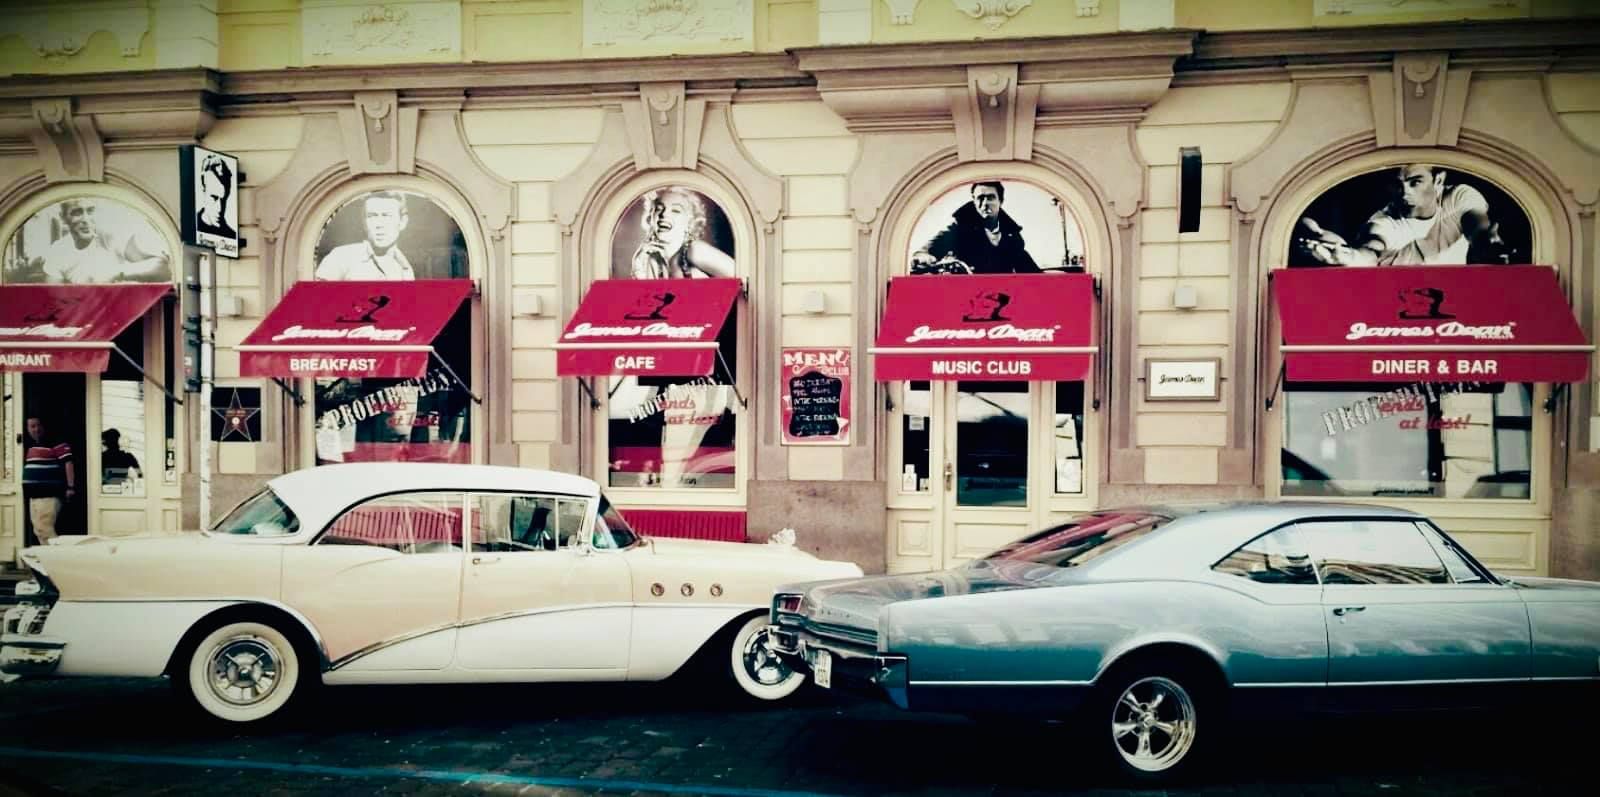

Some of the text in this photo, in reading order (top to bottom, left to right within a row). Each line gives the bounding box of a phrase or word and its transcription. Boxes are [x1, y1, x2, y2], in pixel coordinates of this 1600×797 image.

[564, 322, 642, 339] James
[905, 325, 986, 343] James
[987, 324, 1055, 341] Dean
[1345, 322, 1434, 340] James
[1436, 321, 1513, 337] Dean
[289, 358, 377, 371] BREAKFAST
[614, 356, 656, 370] CAFE
[783, 350, 849, 367] MENU
[932, 360, 1032, 375] MUSIC CLUB
[1372, 359, 1498, 375] DINER & BAR
[1378, 395, 1425, 413] ends
[1399, 416, 1421, 430] at
